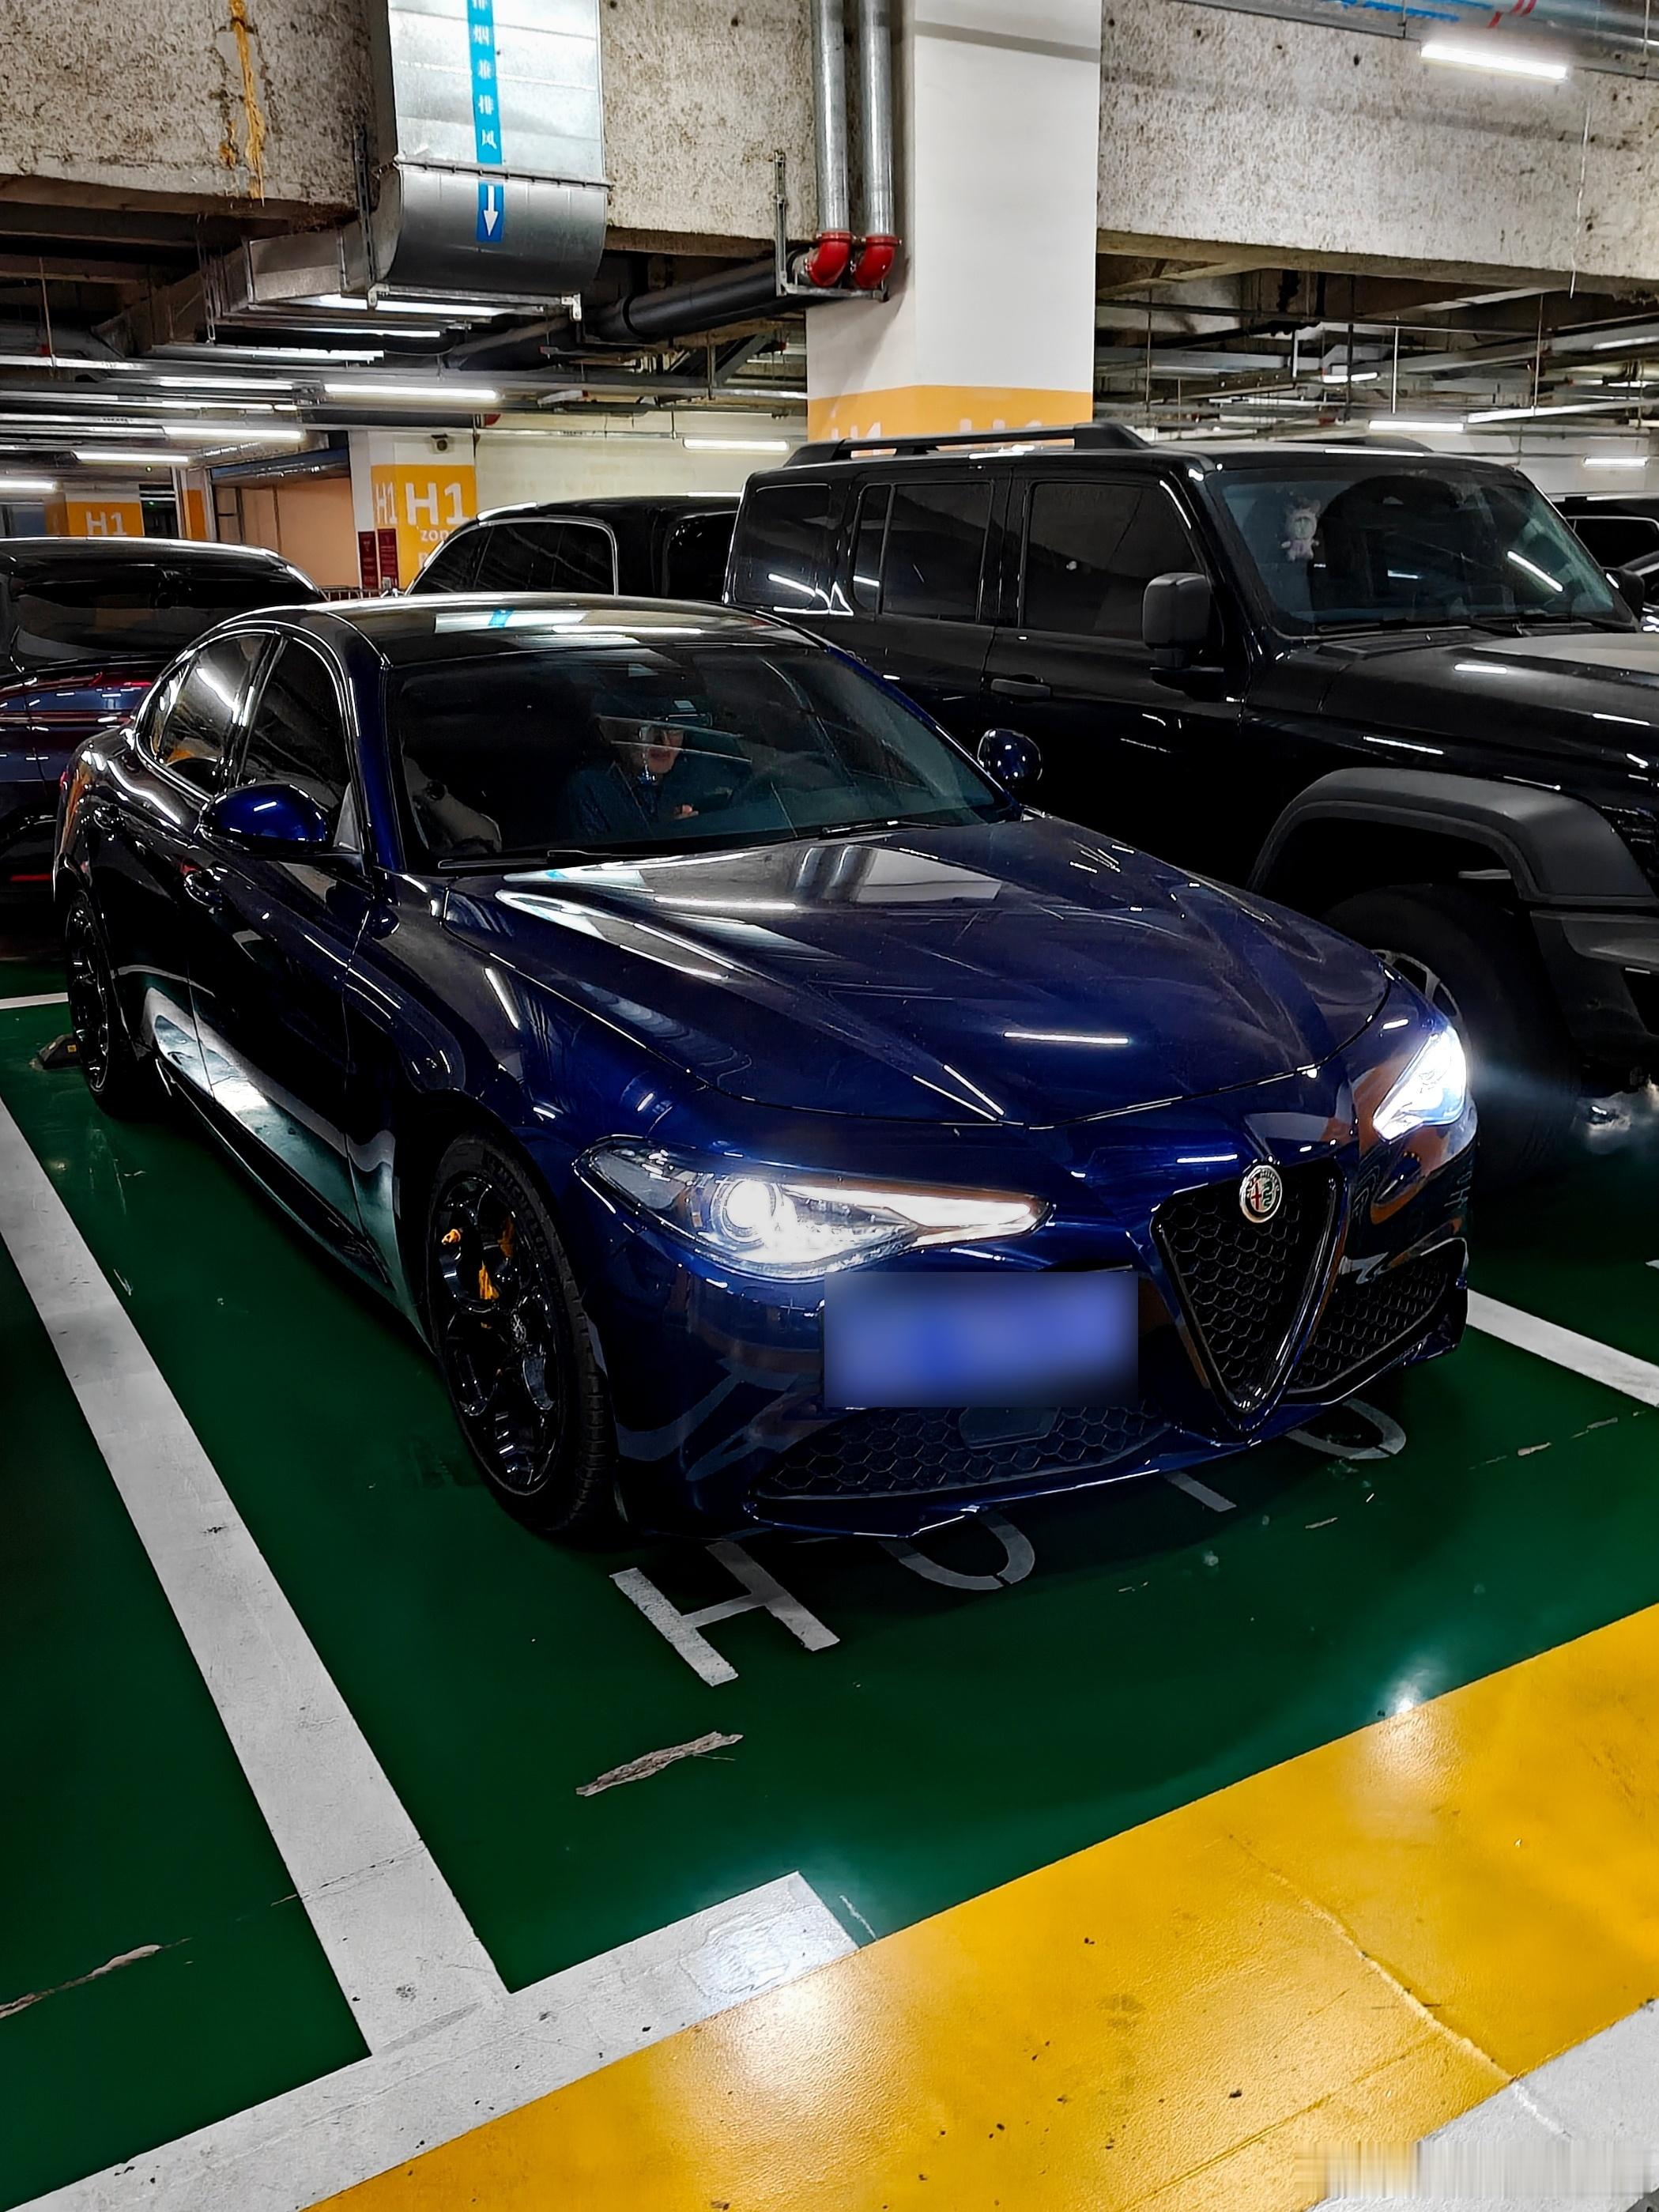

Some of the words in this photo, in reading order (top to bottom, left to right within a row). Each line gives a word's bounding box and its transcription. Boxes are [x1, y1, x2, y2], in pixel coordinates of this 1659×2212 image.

[376, 481, 398, 525] H1
[405, 482, 470, 525] H1
[85, 511, 127, 536] H1
[420, 530, 450, 542] zon
